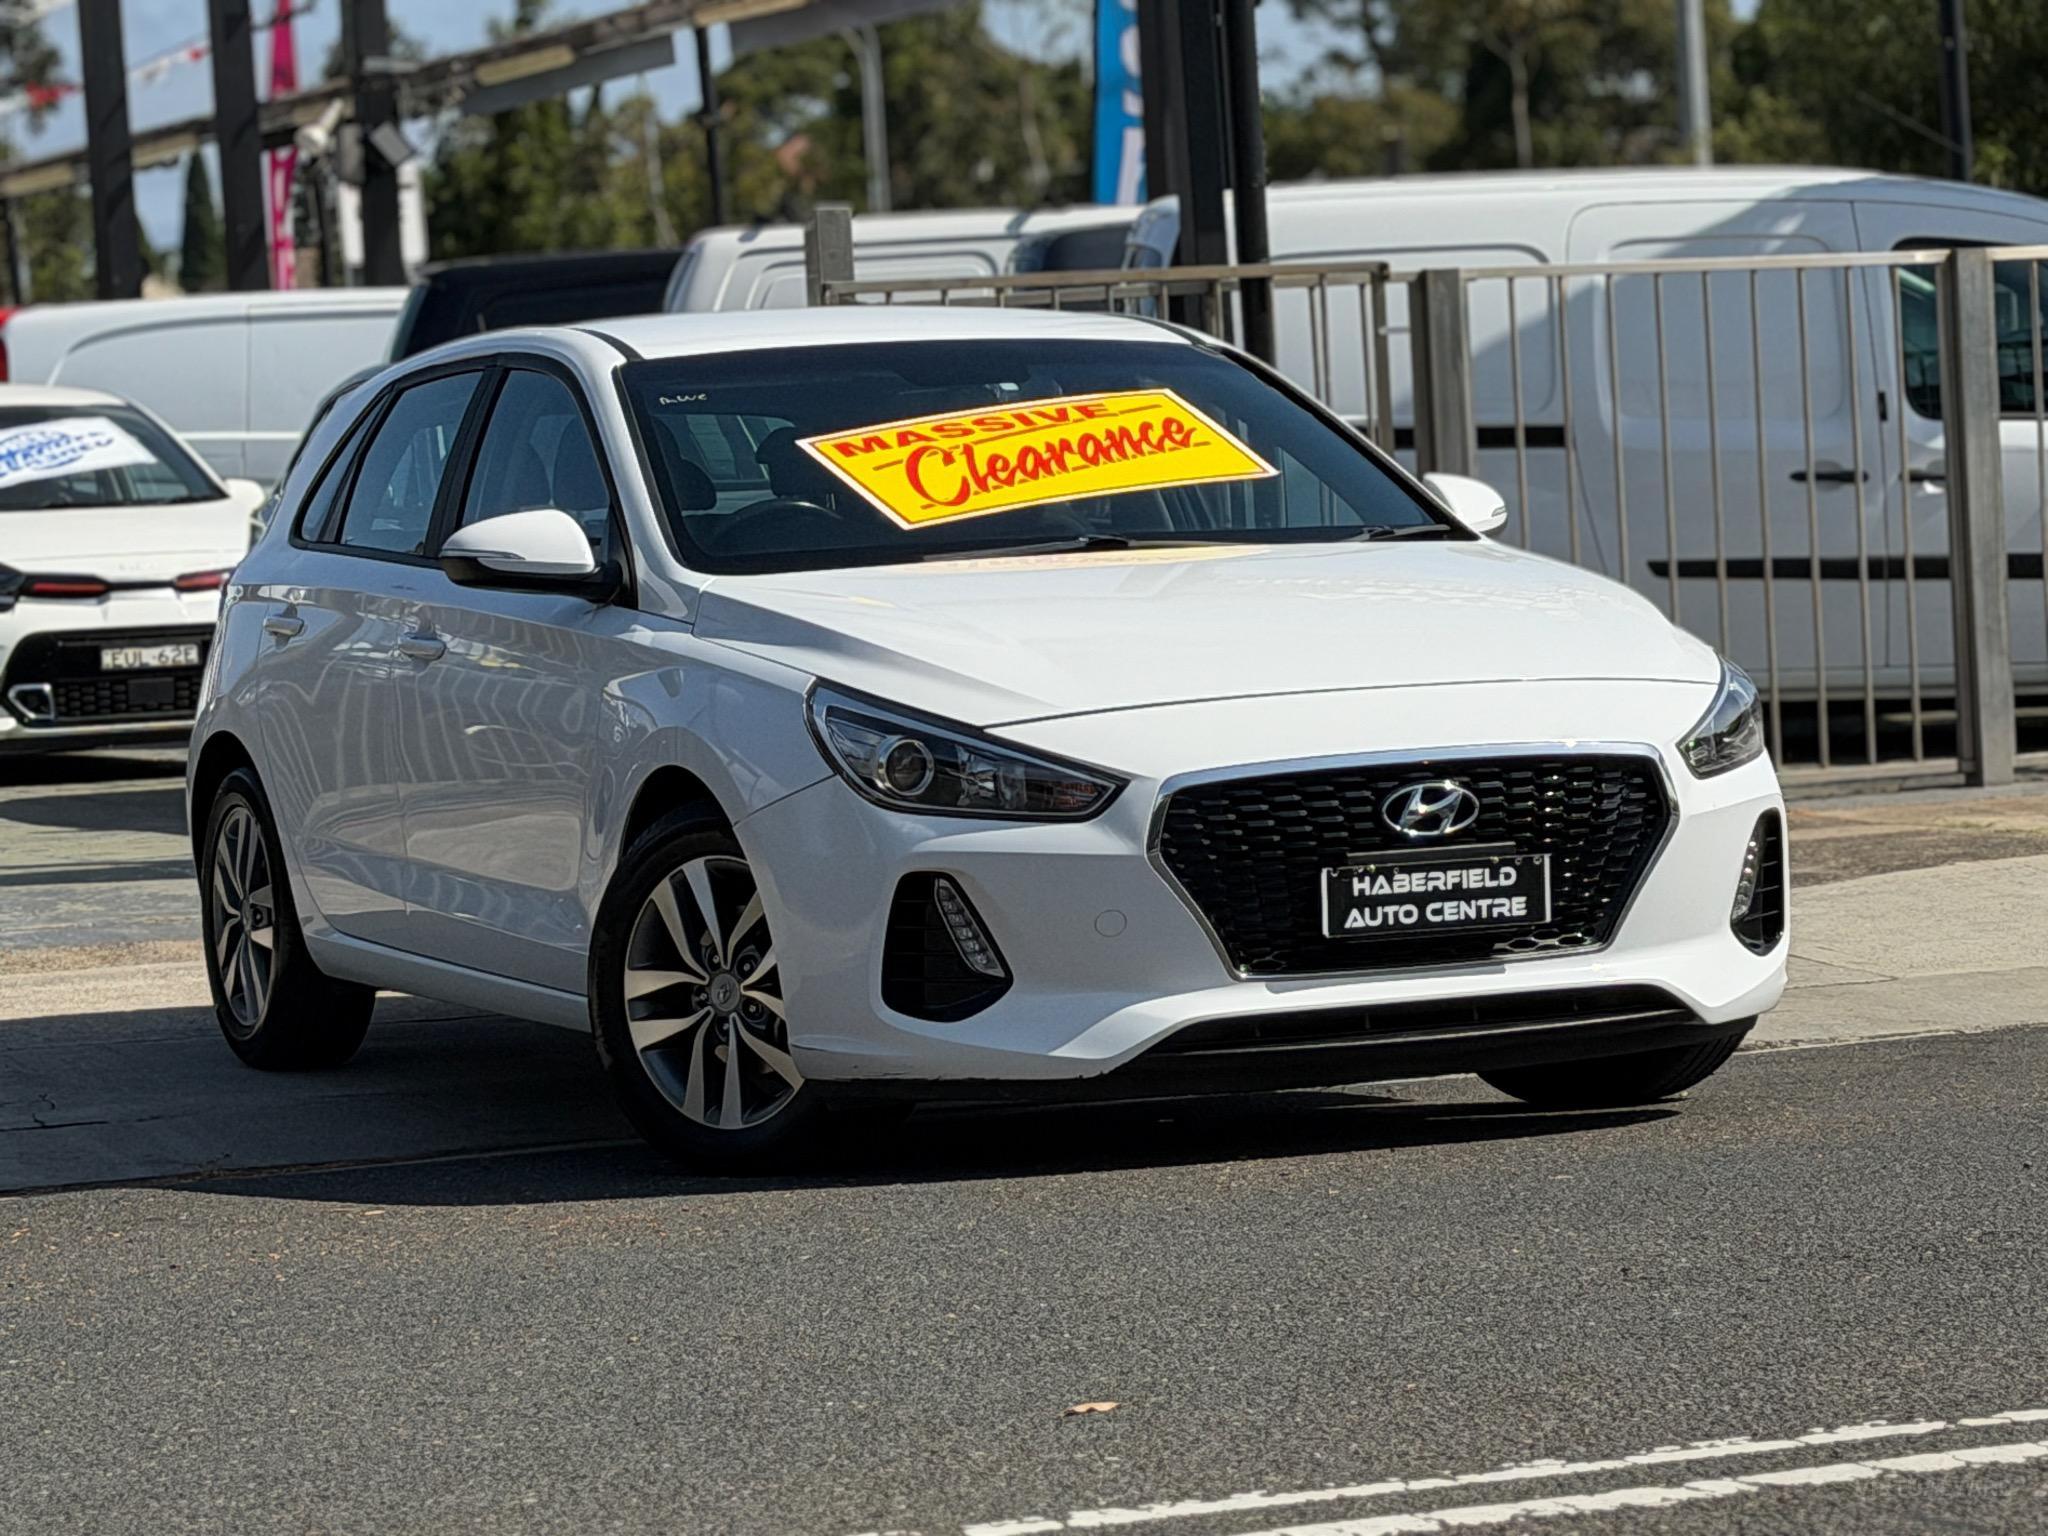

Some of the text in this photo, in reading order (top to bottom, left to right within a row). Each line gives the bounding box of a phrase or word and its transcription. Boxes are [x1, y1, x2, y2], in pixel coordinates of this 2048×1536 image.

[833, 403, 1107, 458] MASSIVE
[905, 416, 1197, 507] Clearance
[1353, 866, 1517, 897] HABERFIELD
[1344, 896, 1528, 929] AUTO CENTRE
